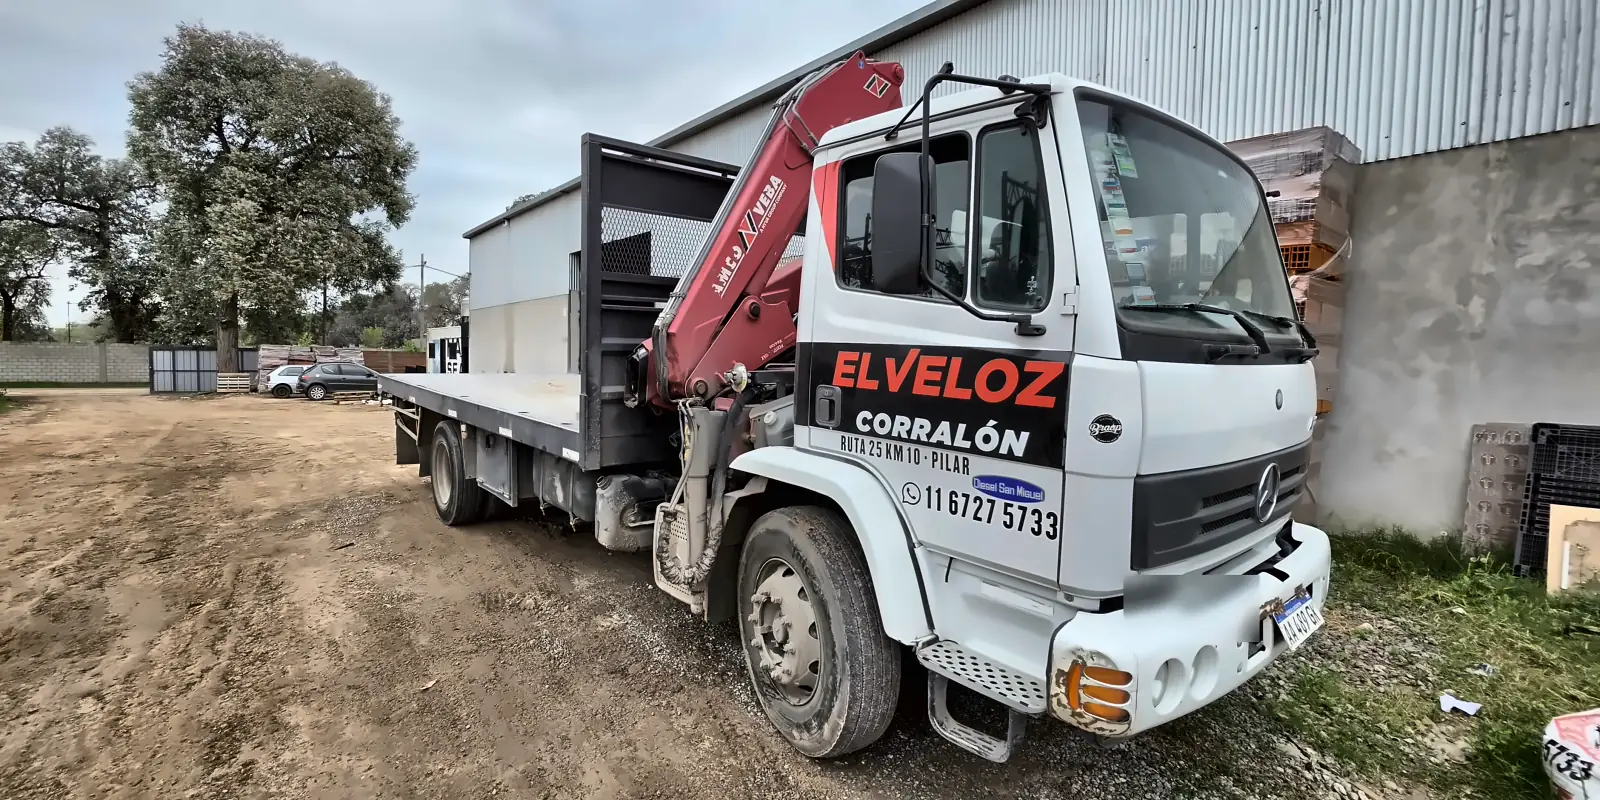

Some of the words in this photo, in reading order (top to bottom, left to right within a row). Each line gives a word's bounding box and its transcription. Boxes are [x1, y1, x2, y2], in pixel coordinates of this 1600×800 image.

[752, 174, 783, 216] VEBA
[832, 351, 879, 390] EL
[885, 349, 1067, 408] VELOZ
[856, 410, 1030, 457] CORRALÓN
[841, 435, 866, 455] RUTA
[869, 440, 882, 458] 25
[886, 443, 904, 462] KM
[907, 446, 920, 466] 10
[931, 451, 970, 475] PILAR
[973, 478, 998, 492] Diesel
[999, 482, 1015, 496] San
[926, 485, 941, 512] 11
[949, 491, 996, 524] 6727
[1003, 502, 1058, 540] 5733
[1283, 620, 1300, 646] AA
[1293, 610, 1311, 635] 489
